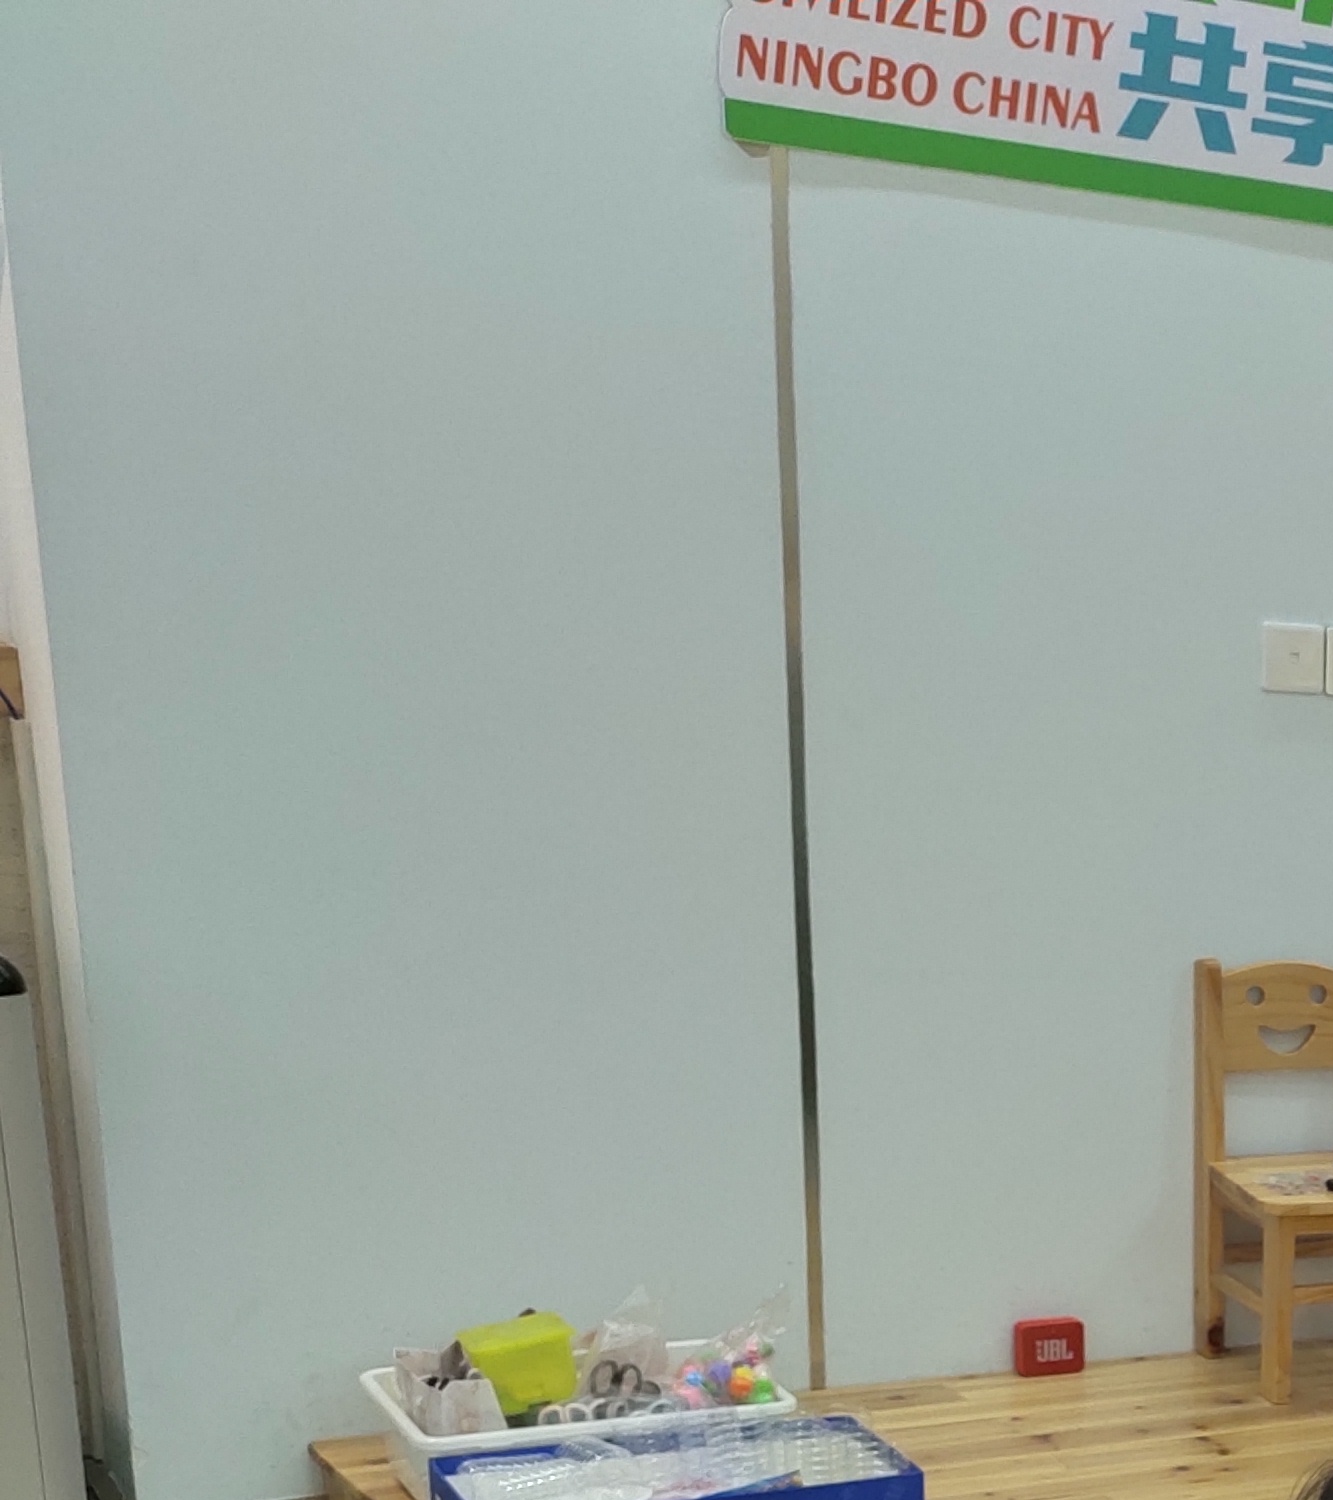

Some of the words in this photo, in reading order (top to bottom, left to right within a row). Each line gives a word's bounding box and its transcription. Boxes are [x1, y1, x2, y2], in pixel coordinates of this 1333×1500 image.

[1009, 6, 1114, 61] CITY
[737, 34, 937, 107] NINGBO
[953, 71, 1101, 133] CHINA
[1036, 1338, 1074, 1363] JBL
